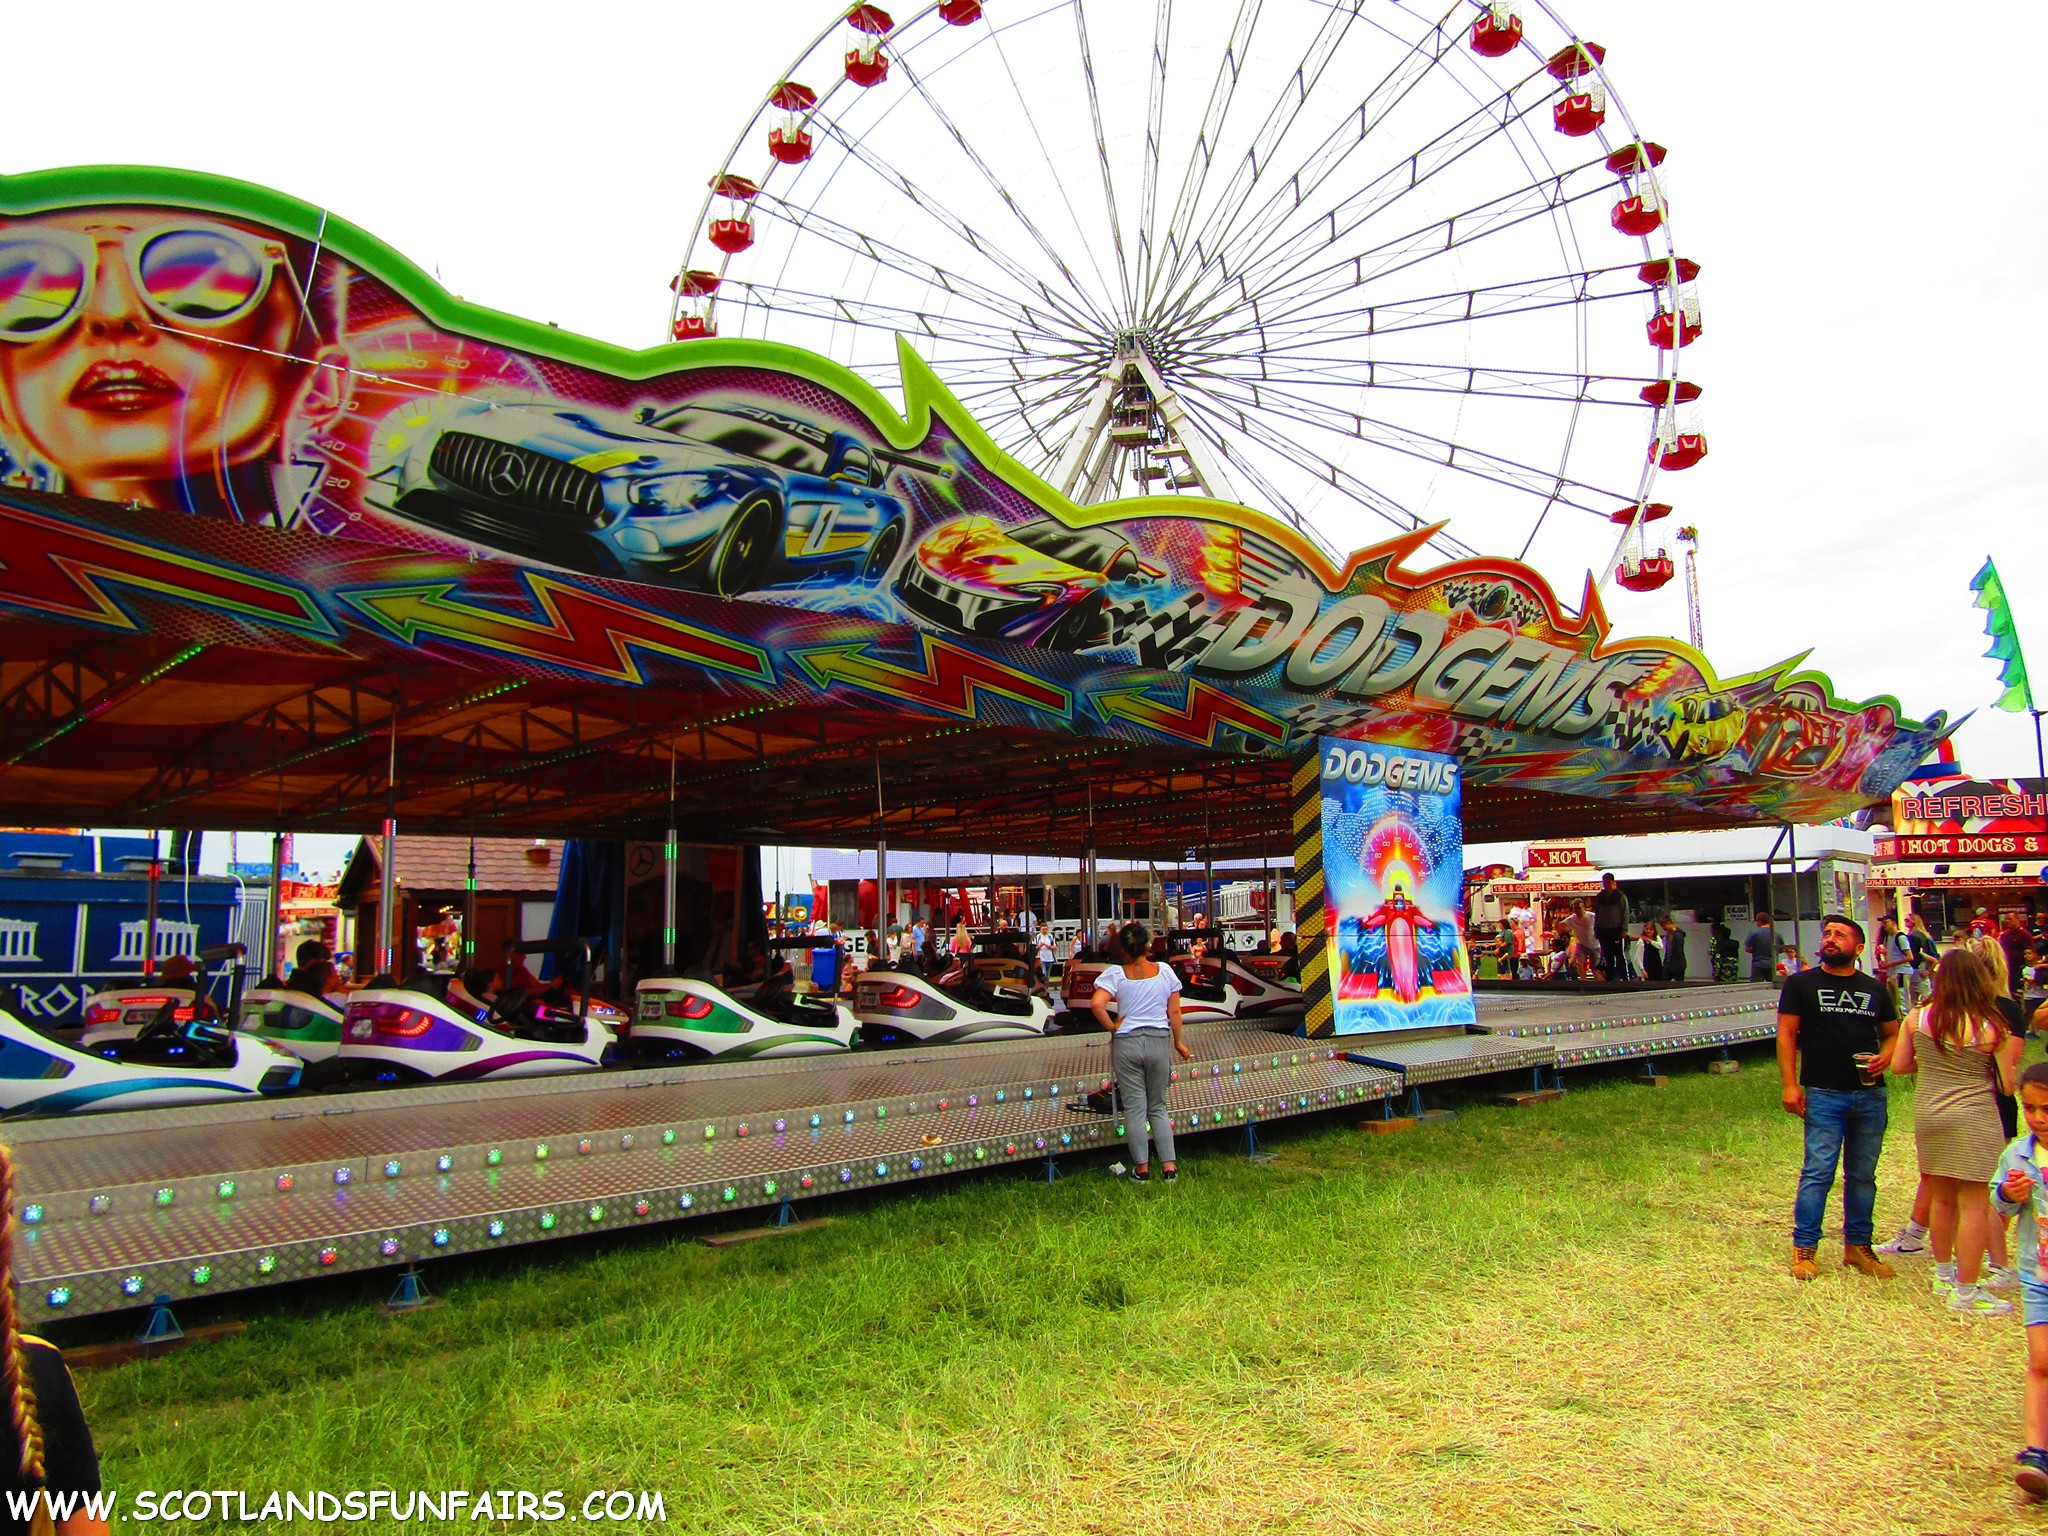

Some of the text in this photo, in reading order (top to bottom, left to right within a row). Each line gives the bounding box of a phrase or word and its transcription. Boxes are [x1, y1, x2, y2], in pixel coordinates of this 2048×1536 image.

[733, 405, 828, 445] AMG
[320, 439, 346, 452] 40
[325, 476, 351, 489] 20
[812, 509, 834, 549] 1
[1198, 588, 1637, 735] DODGEMS
[1323, 747, 1459, 794] DODGEMS
[1902, 793, 2048, 819] REFRESH
[1908, 839, 1950, 854] HOT
[1957, 837, 2016, 854] DOGS
[2024, 837, 2039, 852] &
[1549, 850, 1582, 865] HOT
[1817, 989, 1871, 1010] EA7
